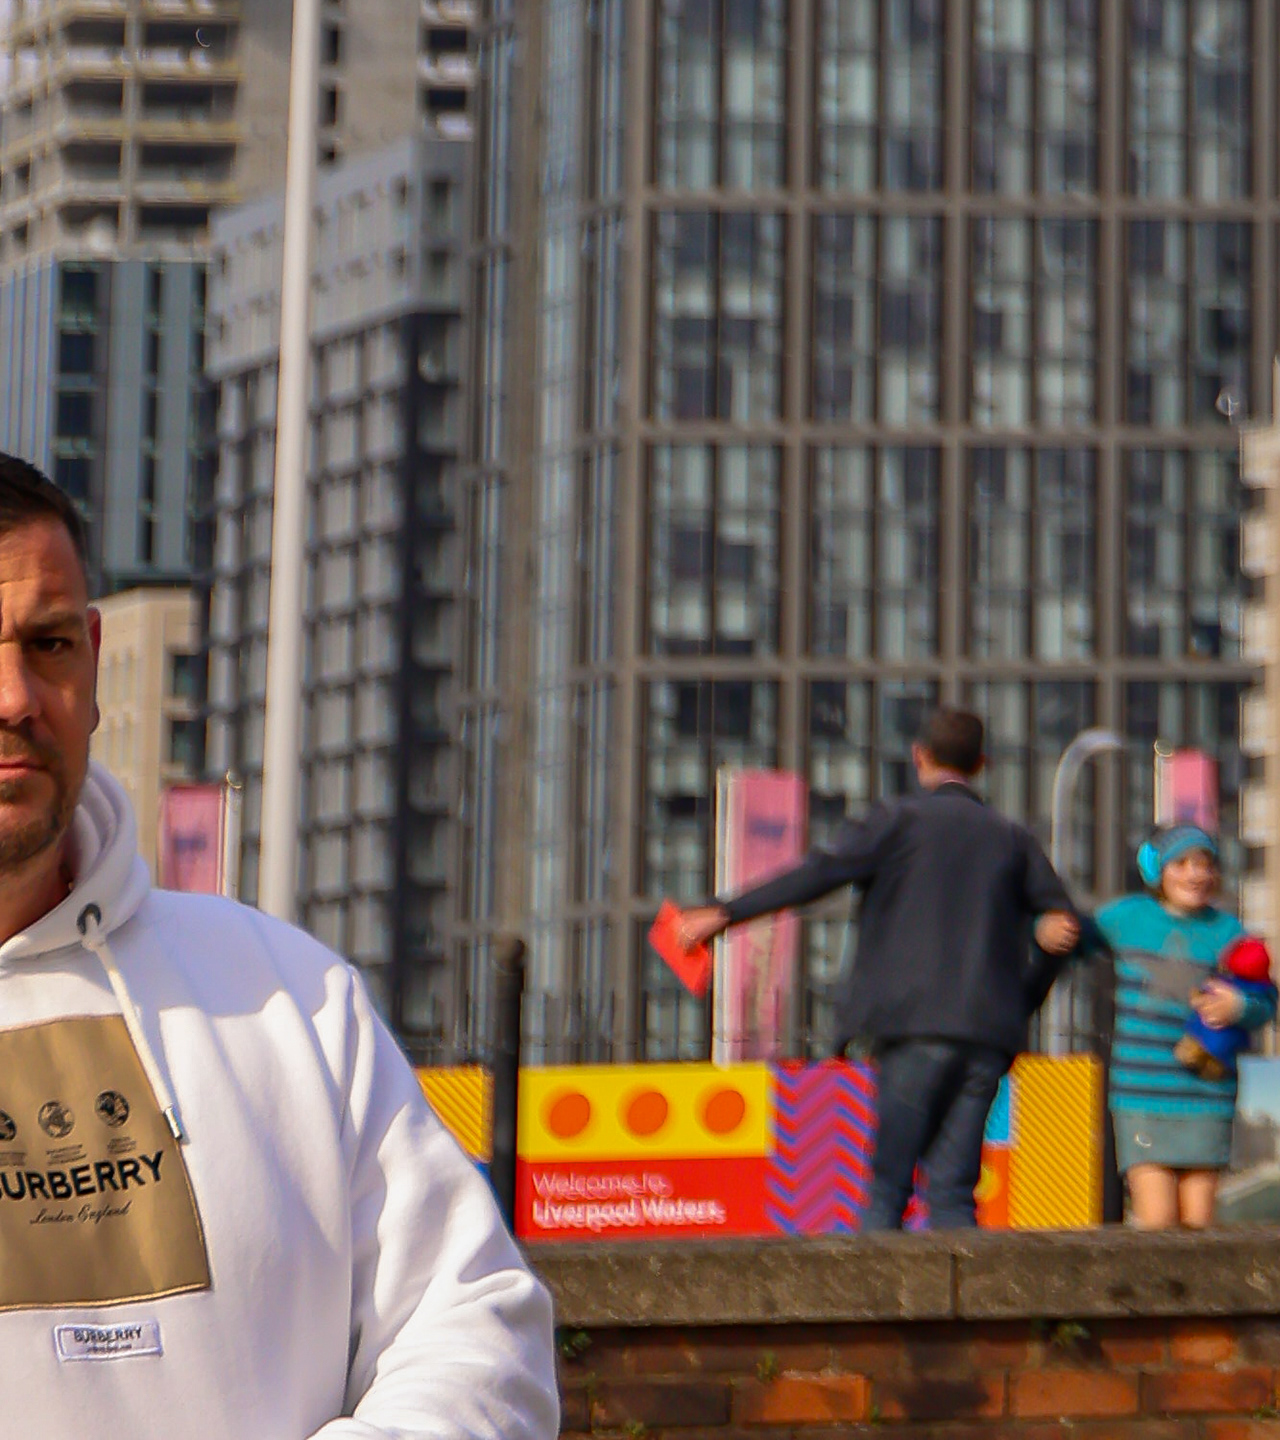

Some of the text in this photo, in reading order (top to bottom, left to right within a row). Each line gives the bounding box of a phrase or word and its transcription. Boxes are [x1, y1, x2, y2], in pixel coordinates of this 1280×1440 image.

[0, 1150, 163, 1200] URBERRY
[532, 1172, 673, 1200] Welcome to
[532, 1198, 643, 1231] Liverpool
